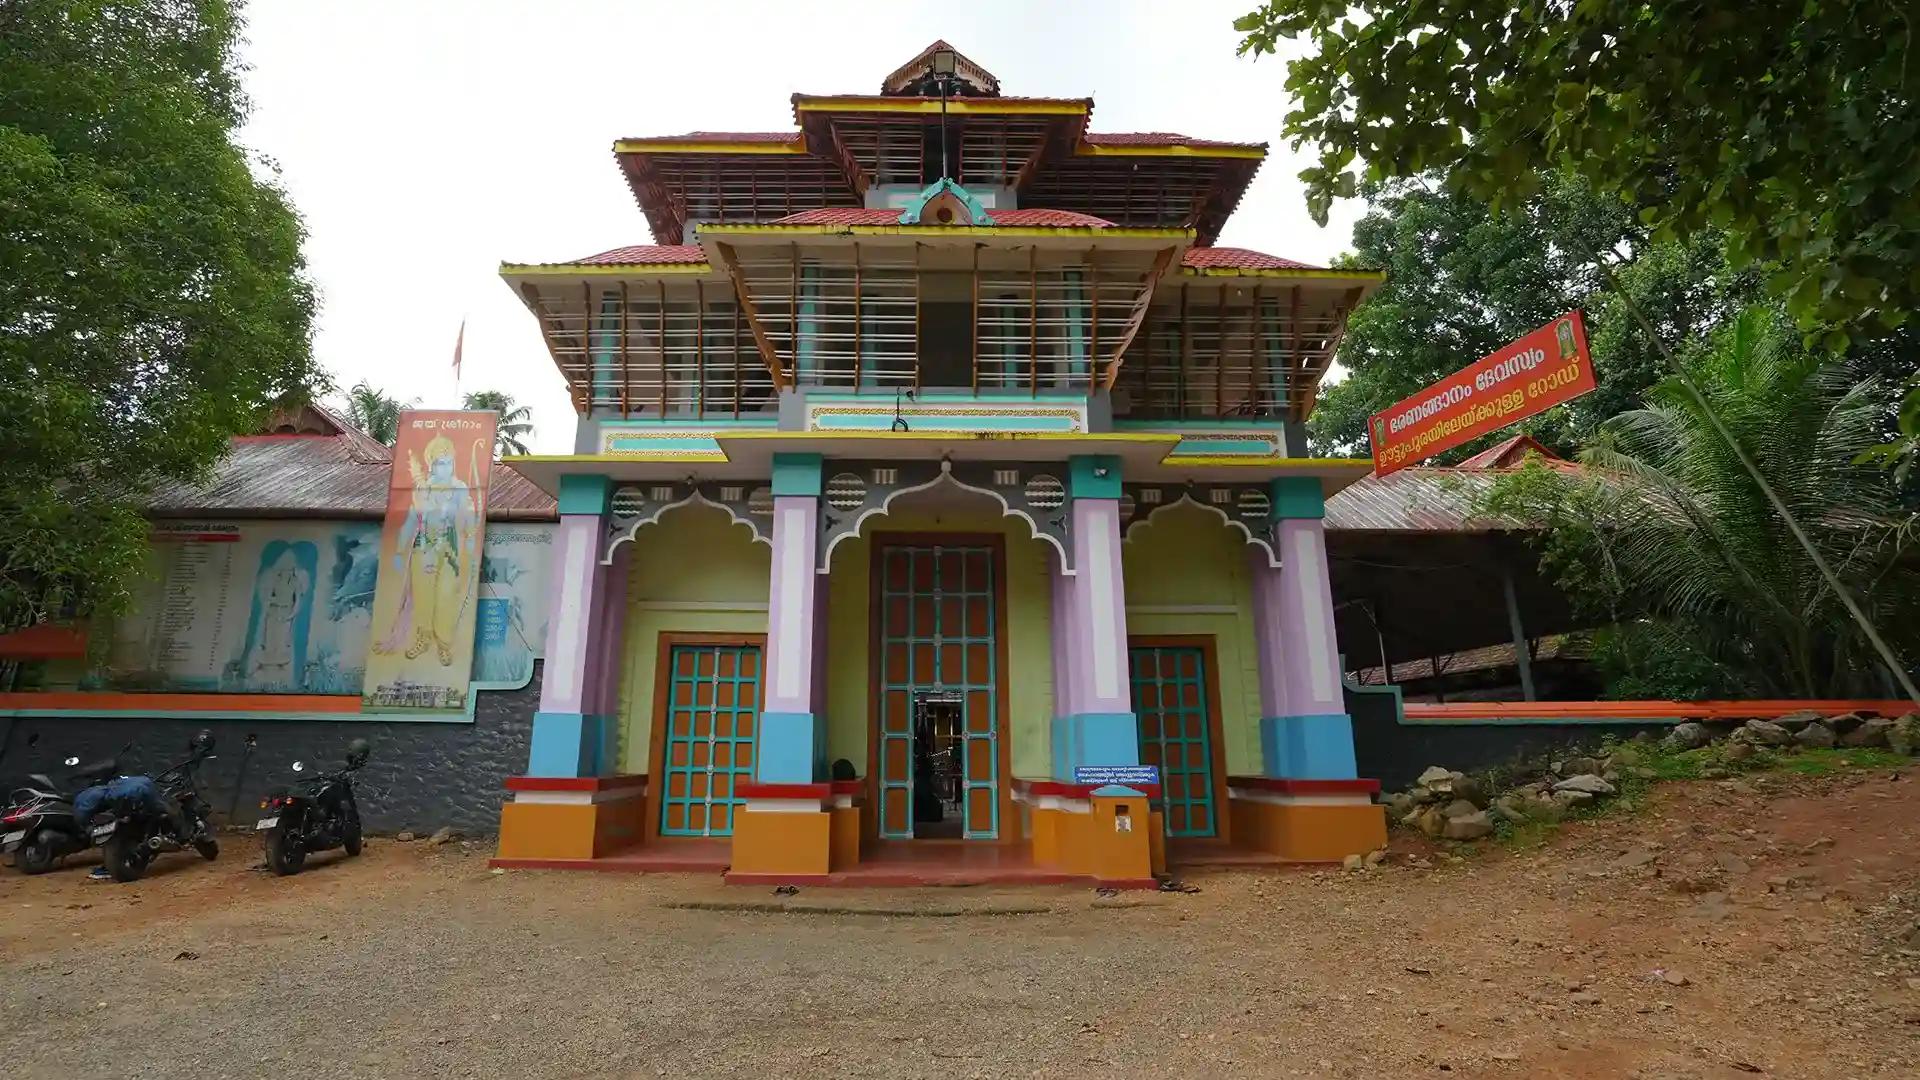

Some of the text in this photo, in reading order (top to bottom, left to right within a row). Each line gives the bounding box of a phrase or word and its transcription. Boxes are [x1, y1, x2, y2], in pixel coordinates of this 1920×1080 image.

[1389, 347, 1545, 434] ഭരണങ്ങാനം ദേവസ്വം
[1528, 356, 1580, 398] റോഡ്
